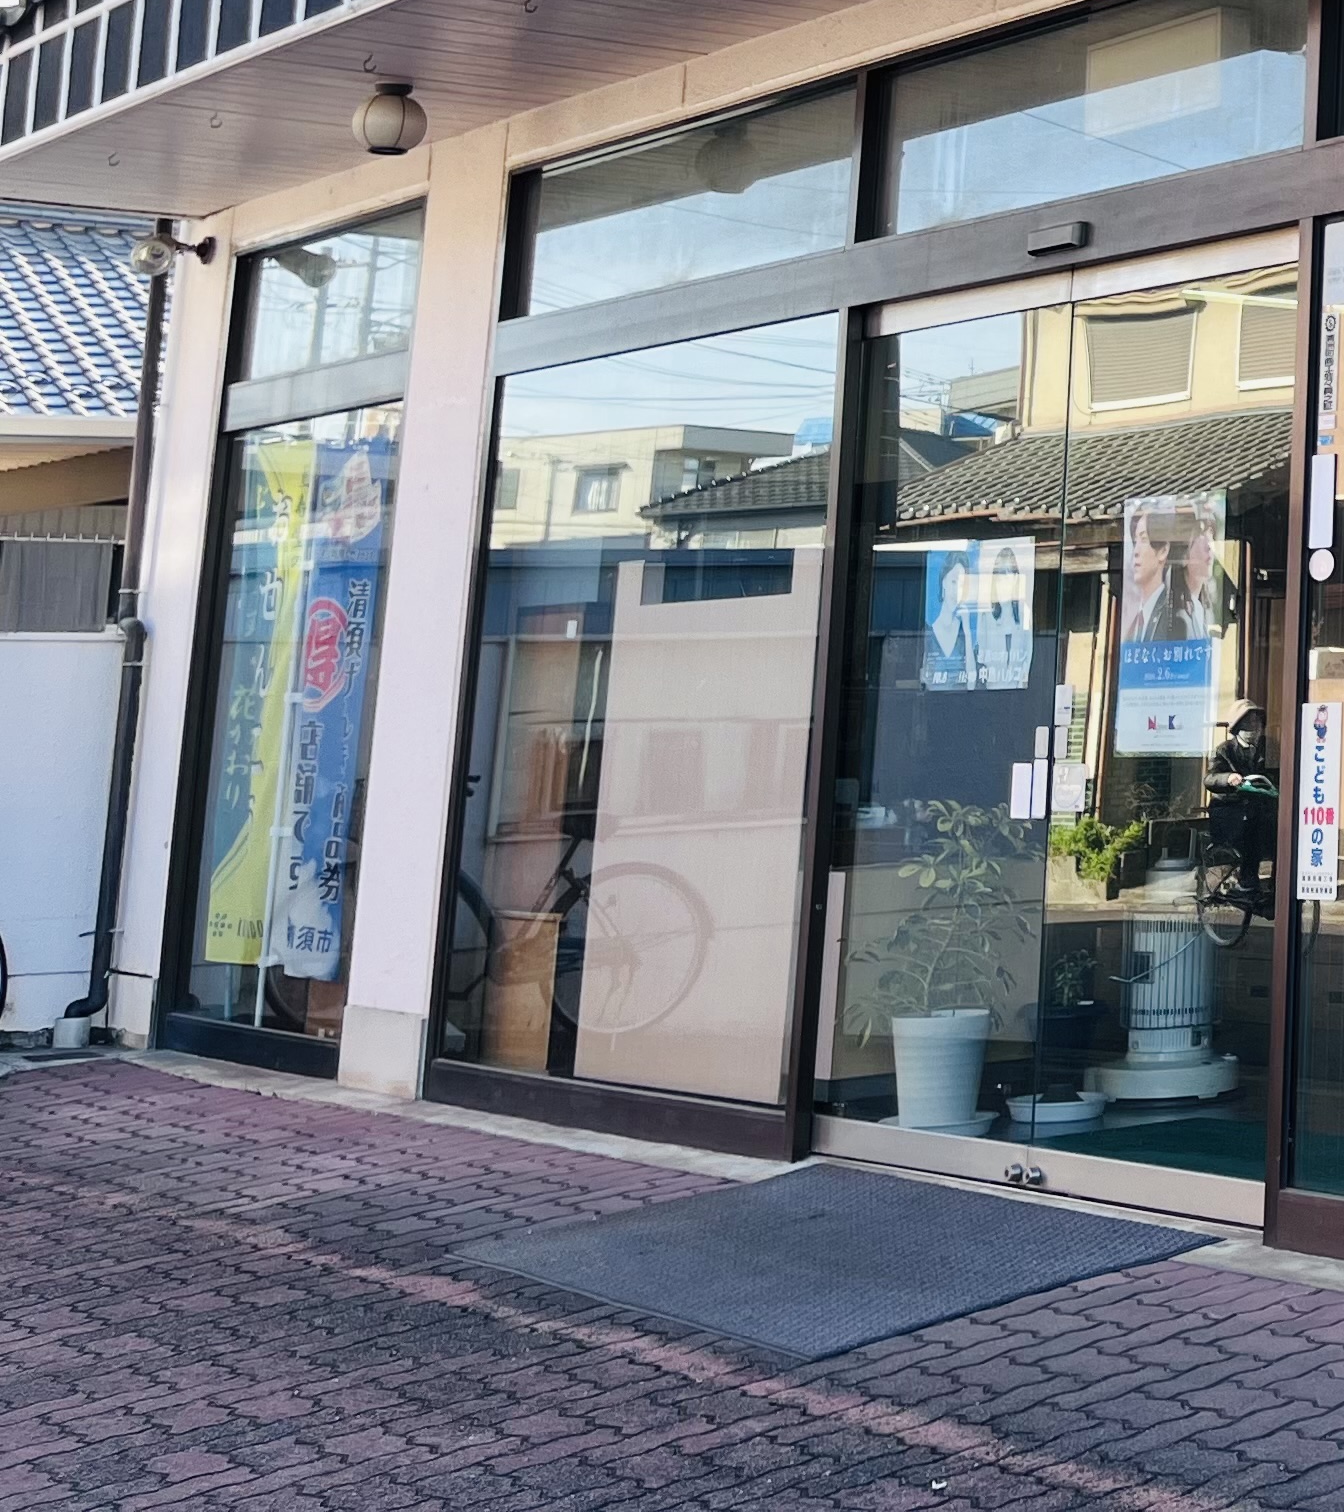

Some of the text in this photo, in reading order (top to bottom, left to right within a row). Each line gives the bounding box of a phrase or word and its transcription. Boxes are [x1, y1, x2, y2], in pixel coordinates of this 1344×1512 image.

[1303, 745, 1335, 867] こども110番の家
